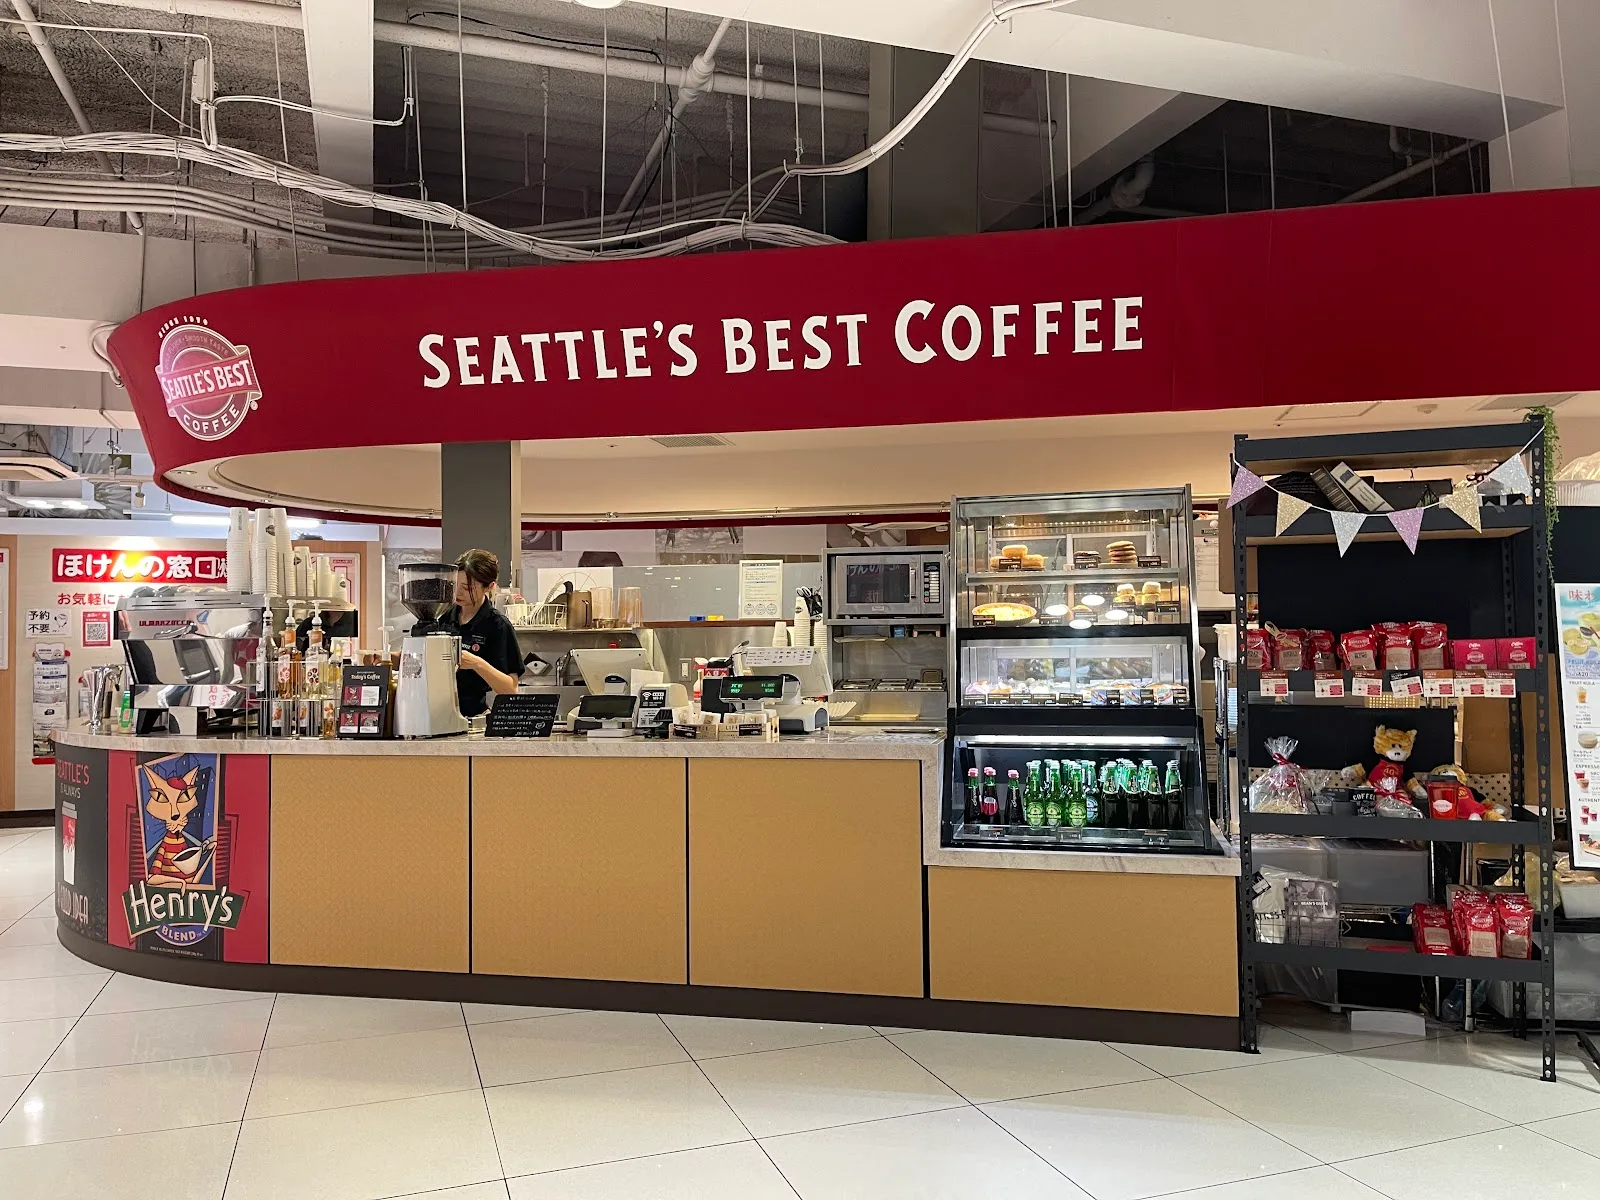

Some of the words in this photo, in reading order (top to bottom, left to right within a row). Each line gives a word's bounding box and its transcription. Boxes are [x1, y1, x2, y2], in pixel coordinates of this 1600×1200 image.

[418, 320, 698, 388] SEATTLE'S
[720, 313, 868, 374] BEST
[894, 296, 1144, 364] COFFEE
[160, 369, 216, 404] SEATTLE'S
[213, 359, 253, 390] BEST
[183, 403, 240, 433] COFFEE
[57, 592, 130, 606] お気軽に
[28, 610, 50, 621] 予約
[28, 623, 50, 634] 不要
[129, 880, 234, 932] Henry's
[161, 925, 197, 941] BLEND
